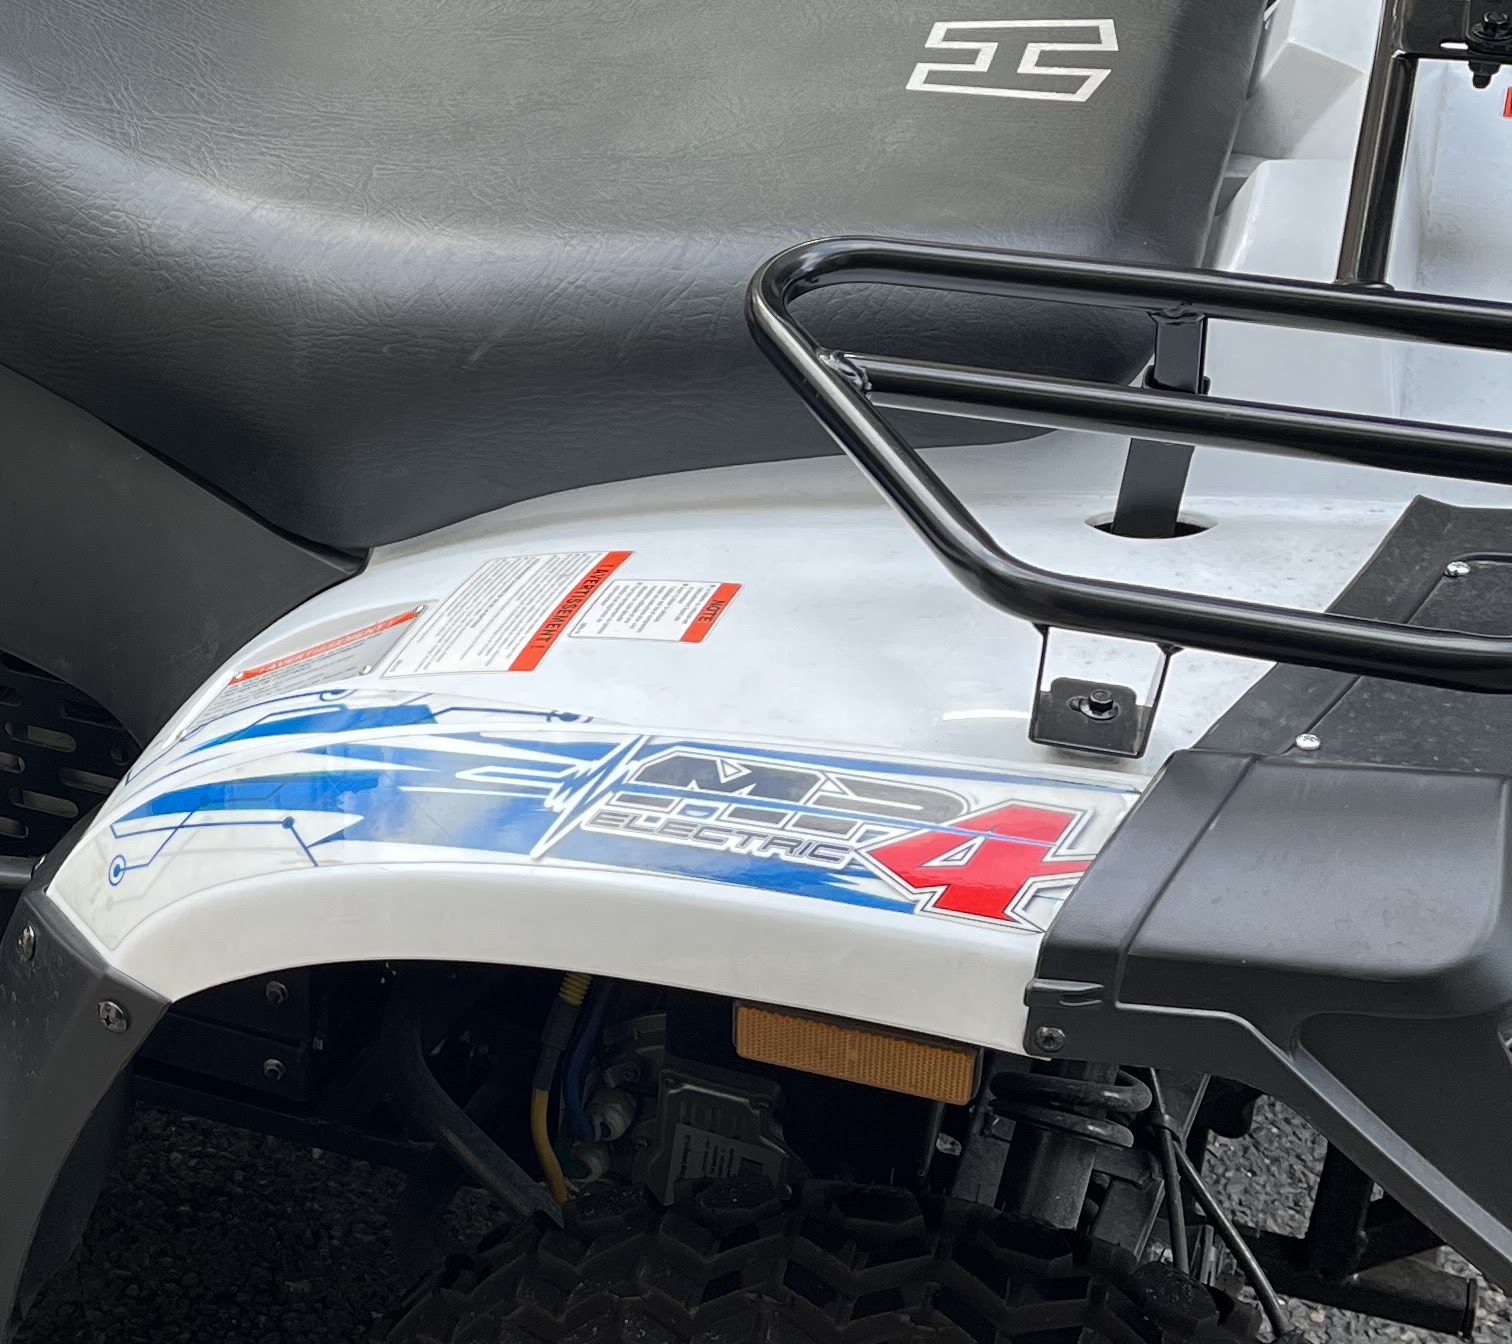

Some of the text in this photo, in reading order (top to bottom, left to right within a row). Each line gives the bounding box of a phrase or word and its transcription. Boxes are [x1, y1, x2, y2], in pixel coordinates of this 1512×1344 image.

[537, 568, 610, 643] AVERTISSEMENT
[697, 599, 726, 623] NOTE
[587, 808, 855, 863] ELECTRIC
